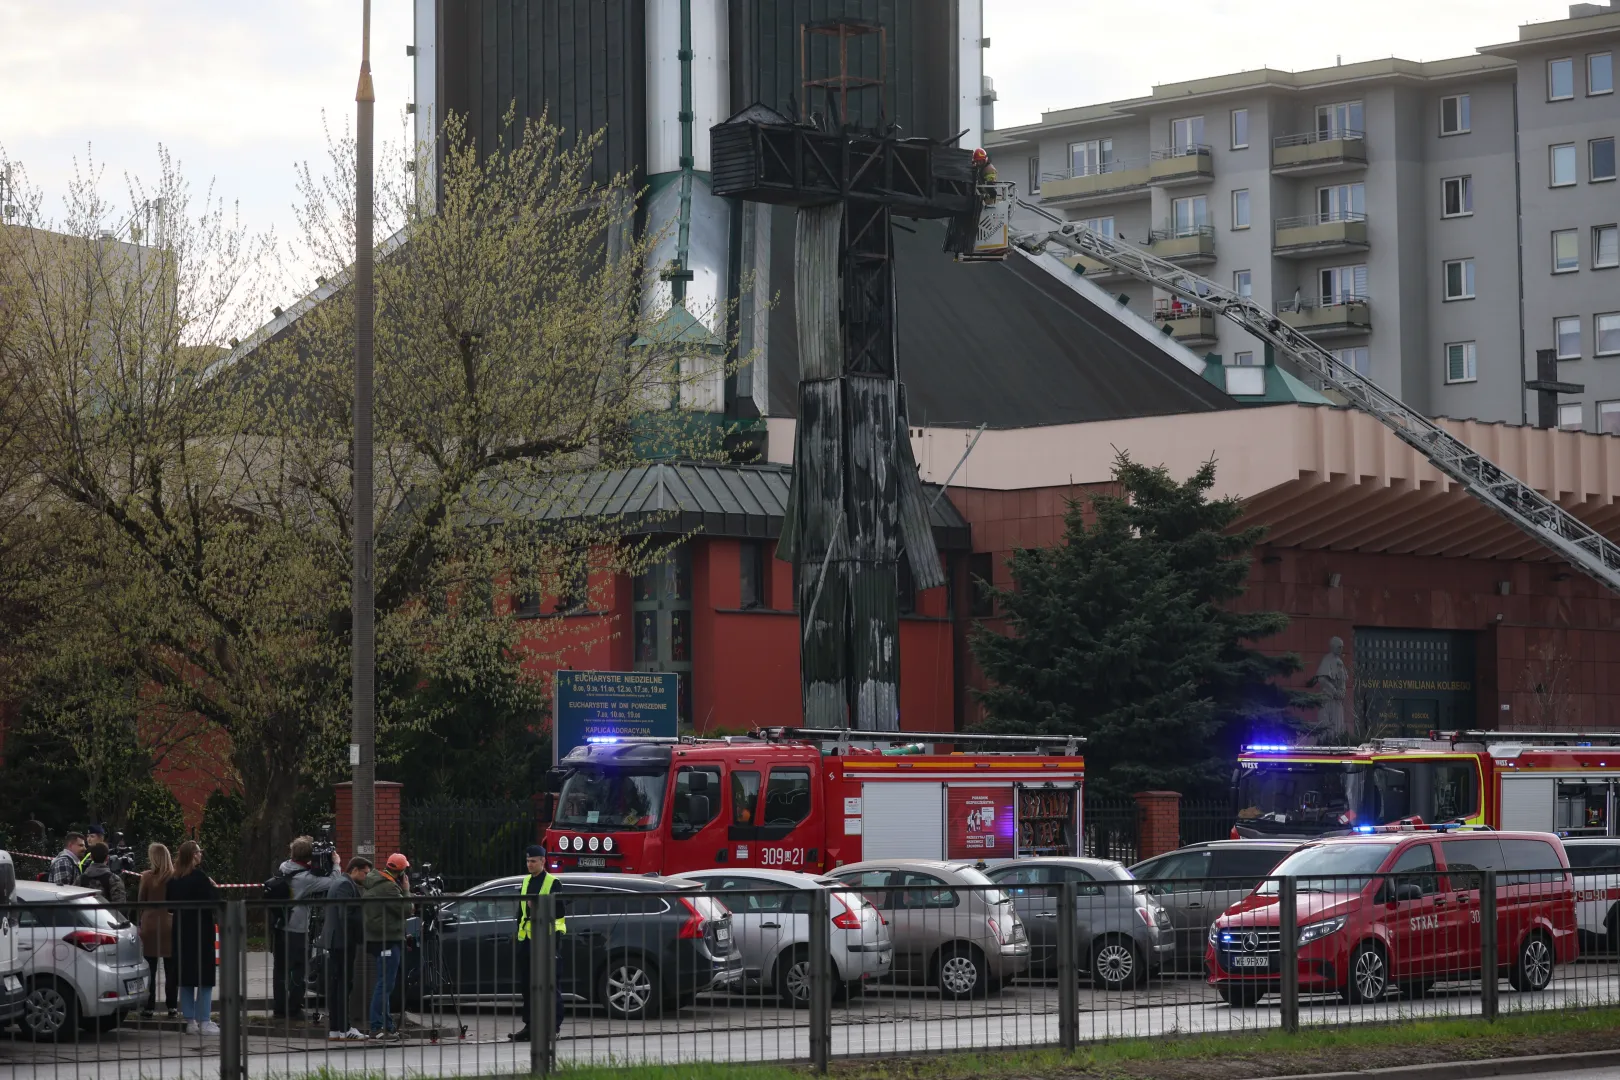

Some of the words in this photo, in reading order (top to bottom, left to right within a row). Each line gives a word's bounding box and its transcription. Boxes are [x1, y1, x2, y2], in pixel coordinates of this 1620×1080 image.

[983, 220, 1005, 242] MAGIRUS
[574, 674, 621, 683] EUCHARYSTIE
[624, 675, 663, 684] NIEDZIELNE
[1382, 680, 1436, 690] MAKSYMILIANA
[1437, 681, 1472, 691] KOLBEGO
[568, 701, 609, 709] EUCHARYSTIE
[631, 702, 667, 710] POWSZEDNIE
[585, 726, 611, 734] KAPLICA
[611, 727, 651, 735] ADORACYJNA
[761, 847, 784, 865] 309
[792, 847, 804, 865] 21
